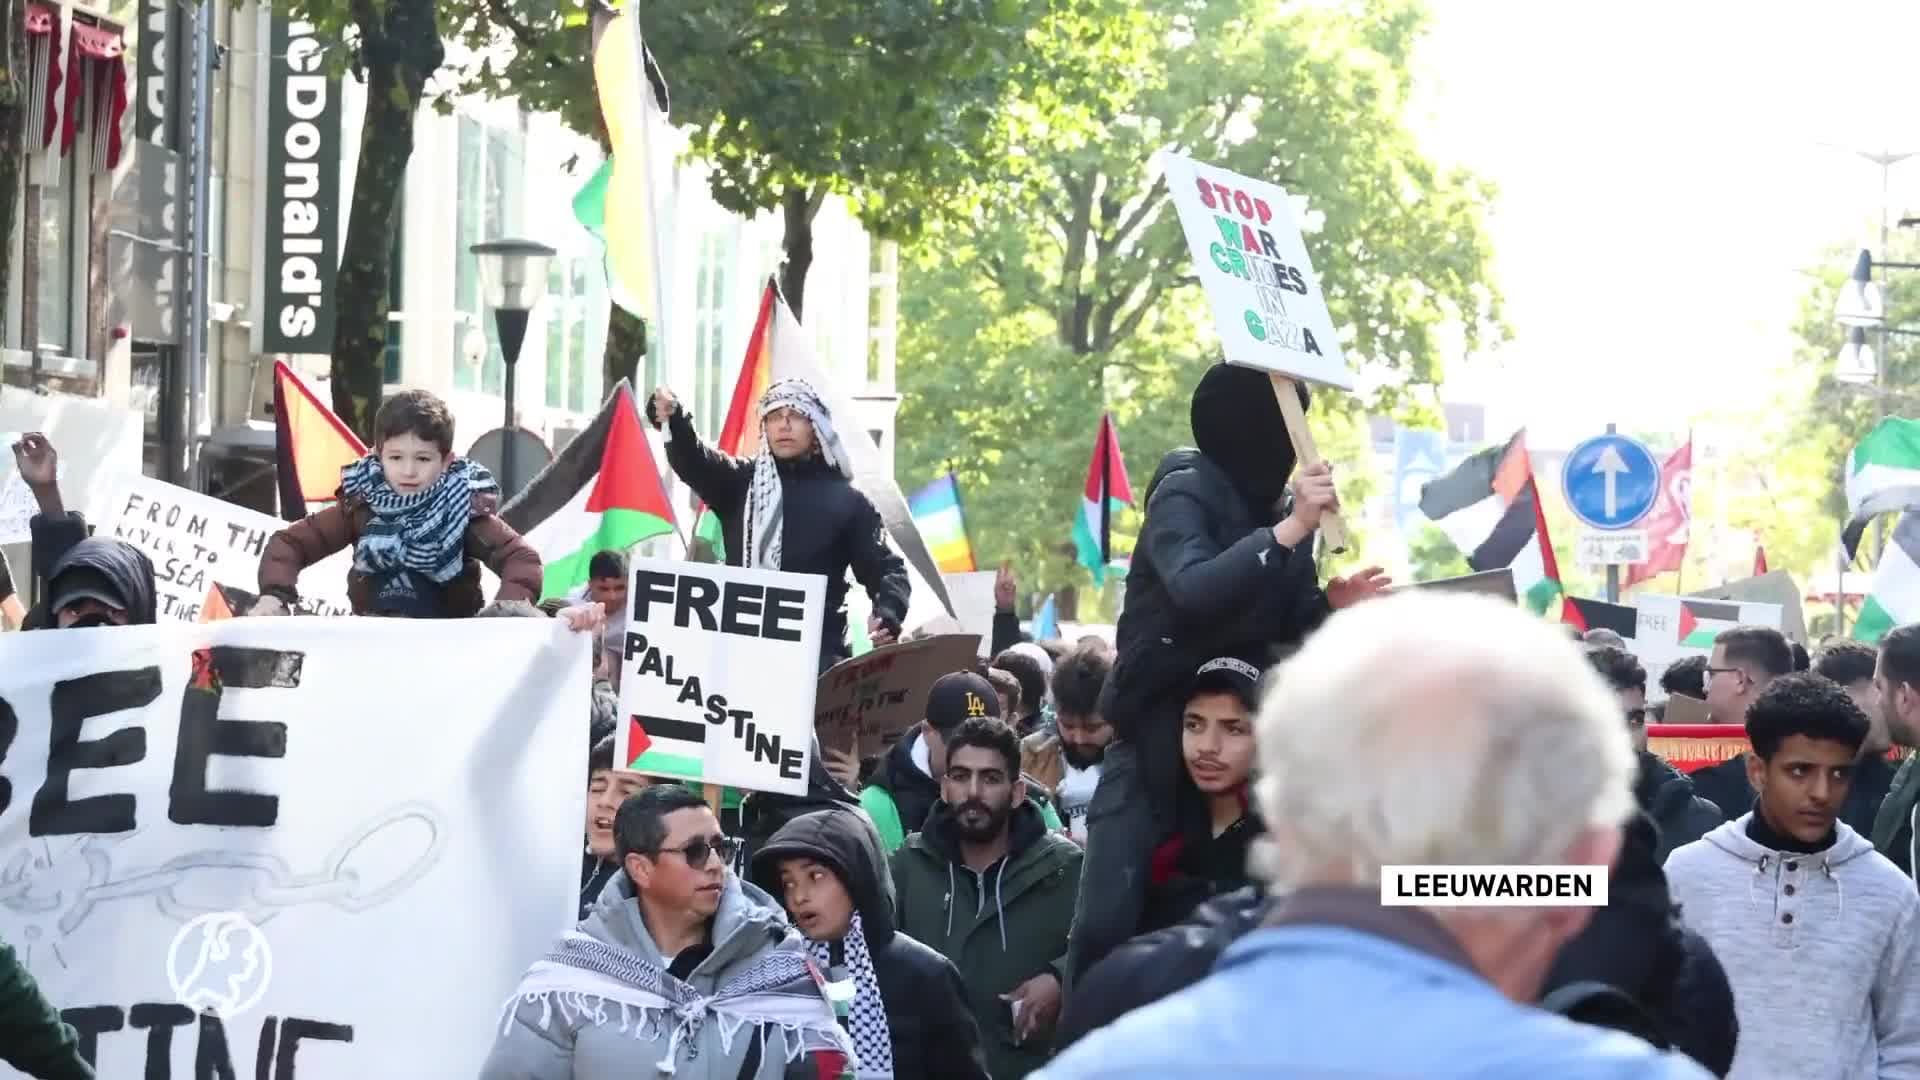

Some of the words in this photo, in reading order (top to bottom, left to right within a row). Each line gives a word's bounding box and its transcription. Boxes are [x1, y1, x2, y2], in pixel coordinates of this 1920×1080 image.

[1196, 176, 1273, 226] STOP
[1214, 214, 1281, 260] WAR
[1209, 241, 1308, 295] CRIMES
[1255, 284, 1287, 318] IN
[1244, 309, 1323, 357] GAZA
[122, 492, 209, 538] FROM
[227, 521, 268, 556] TH
[193, 544, 218, 563] TO
[633, 570, 806, 643] FREE
[624, 631, 805, 780] PALASTINE
[965, 691, 985, 716] LA
